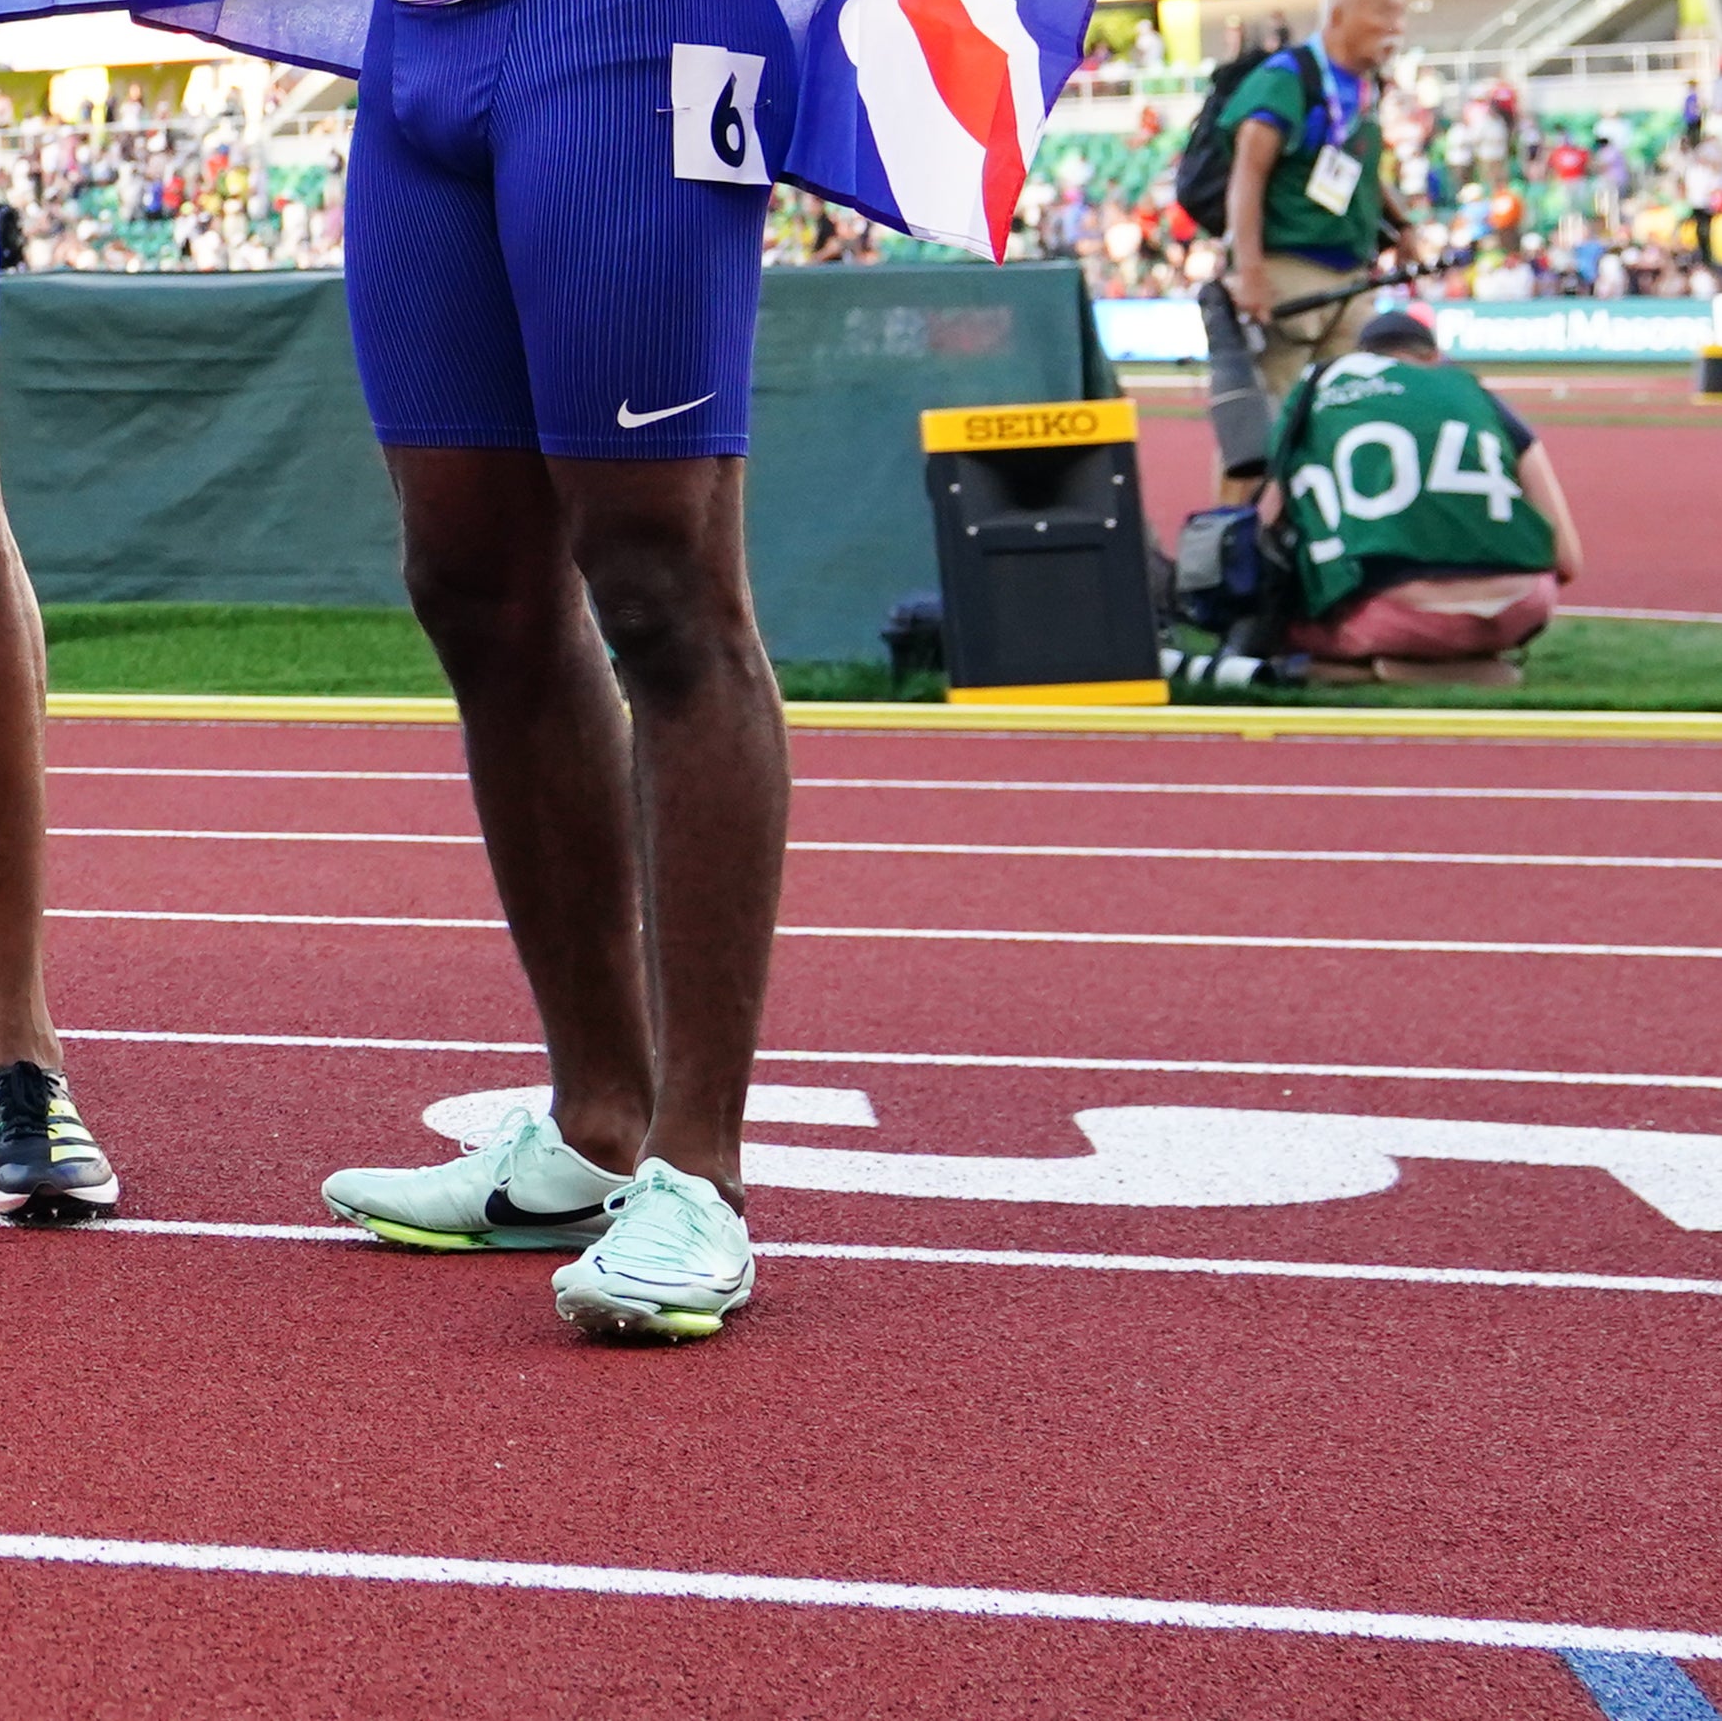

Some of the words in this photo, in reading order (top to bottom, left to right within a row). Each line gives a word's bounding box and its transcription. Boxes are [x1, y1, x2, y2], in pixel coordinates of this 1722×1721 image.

[711, 72, 745, 168] 6
[965, 408, 1099, 443] SEIKO
[1290, 420, 1523, 564] 104
